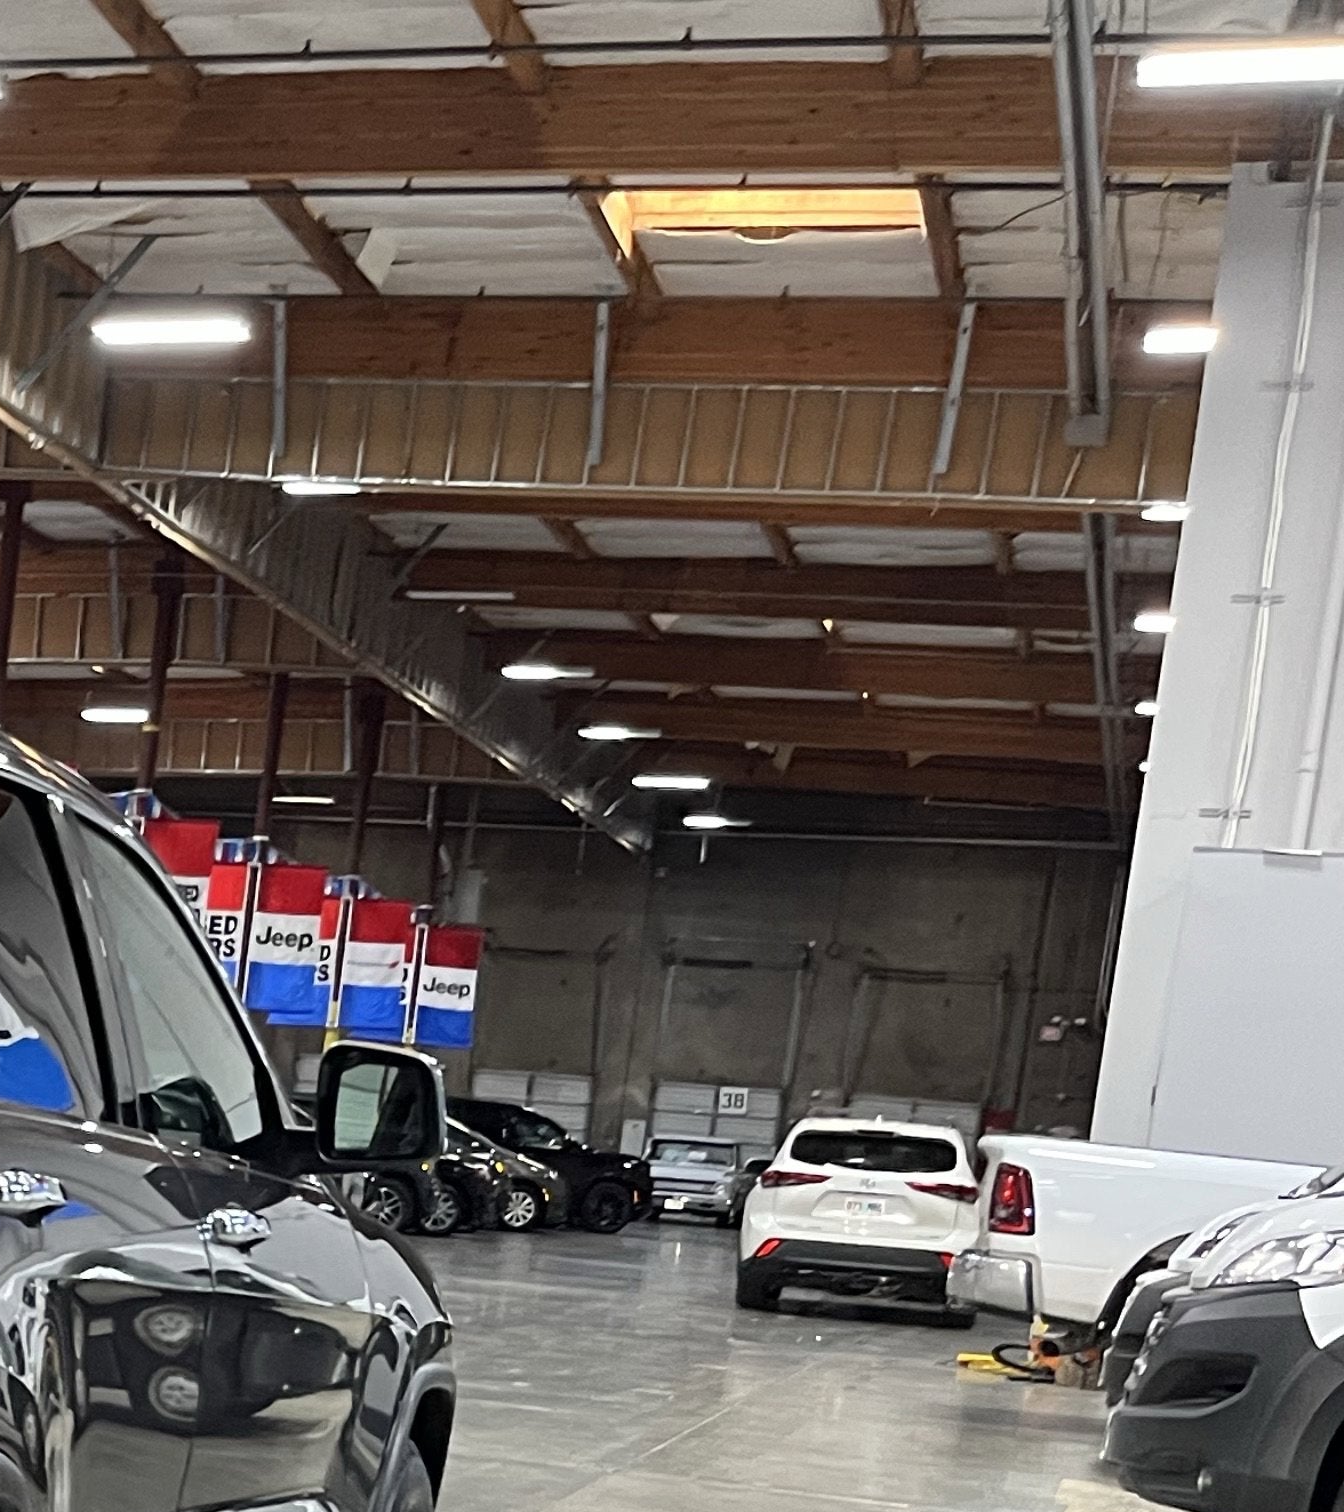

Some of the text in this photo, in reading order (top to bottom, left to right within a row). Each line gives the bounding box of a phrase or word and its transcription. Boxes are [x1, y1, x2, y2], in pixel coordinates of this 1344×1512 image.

[208, 915, 239, 936] ED
[256, 926, 314, 952] Jeep
[423, 977, 471, 999] Jeep
